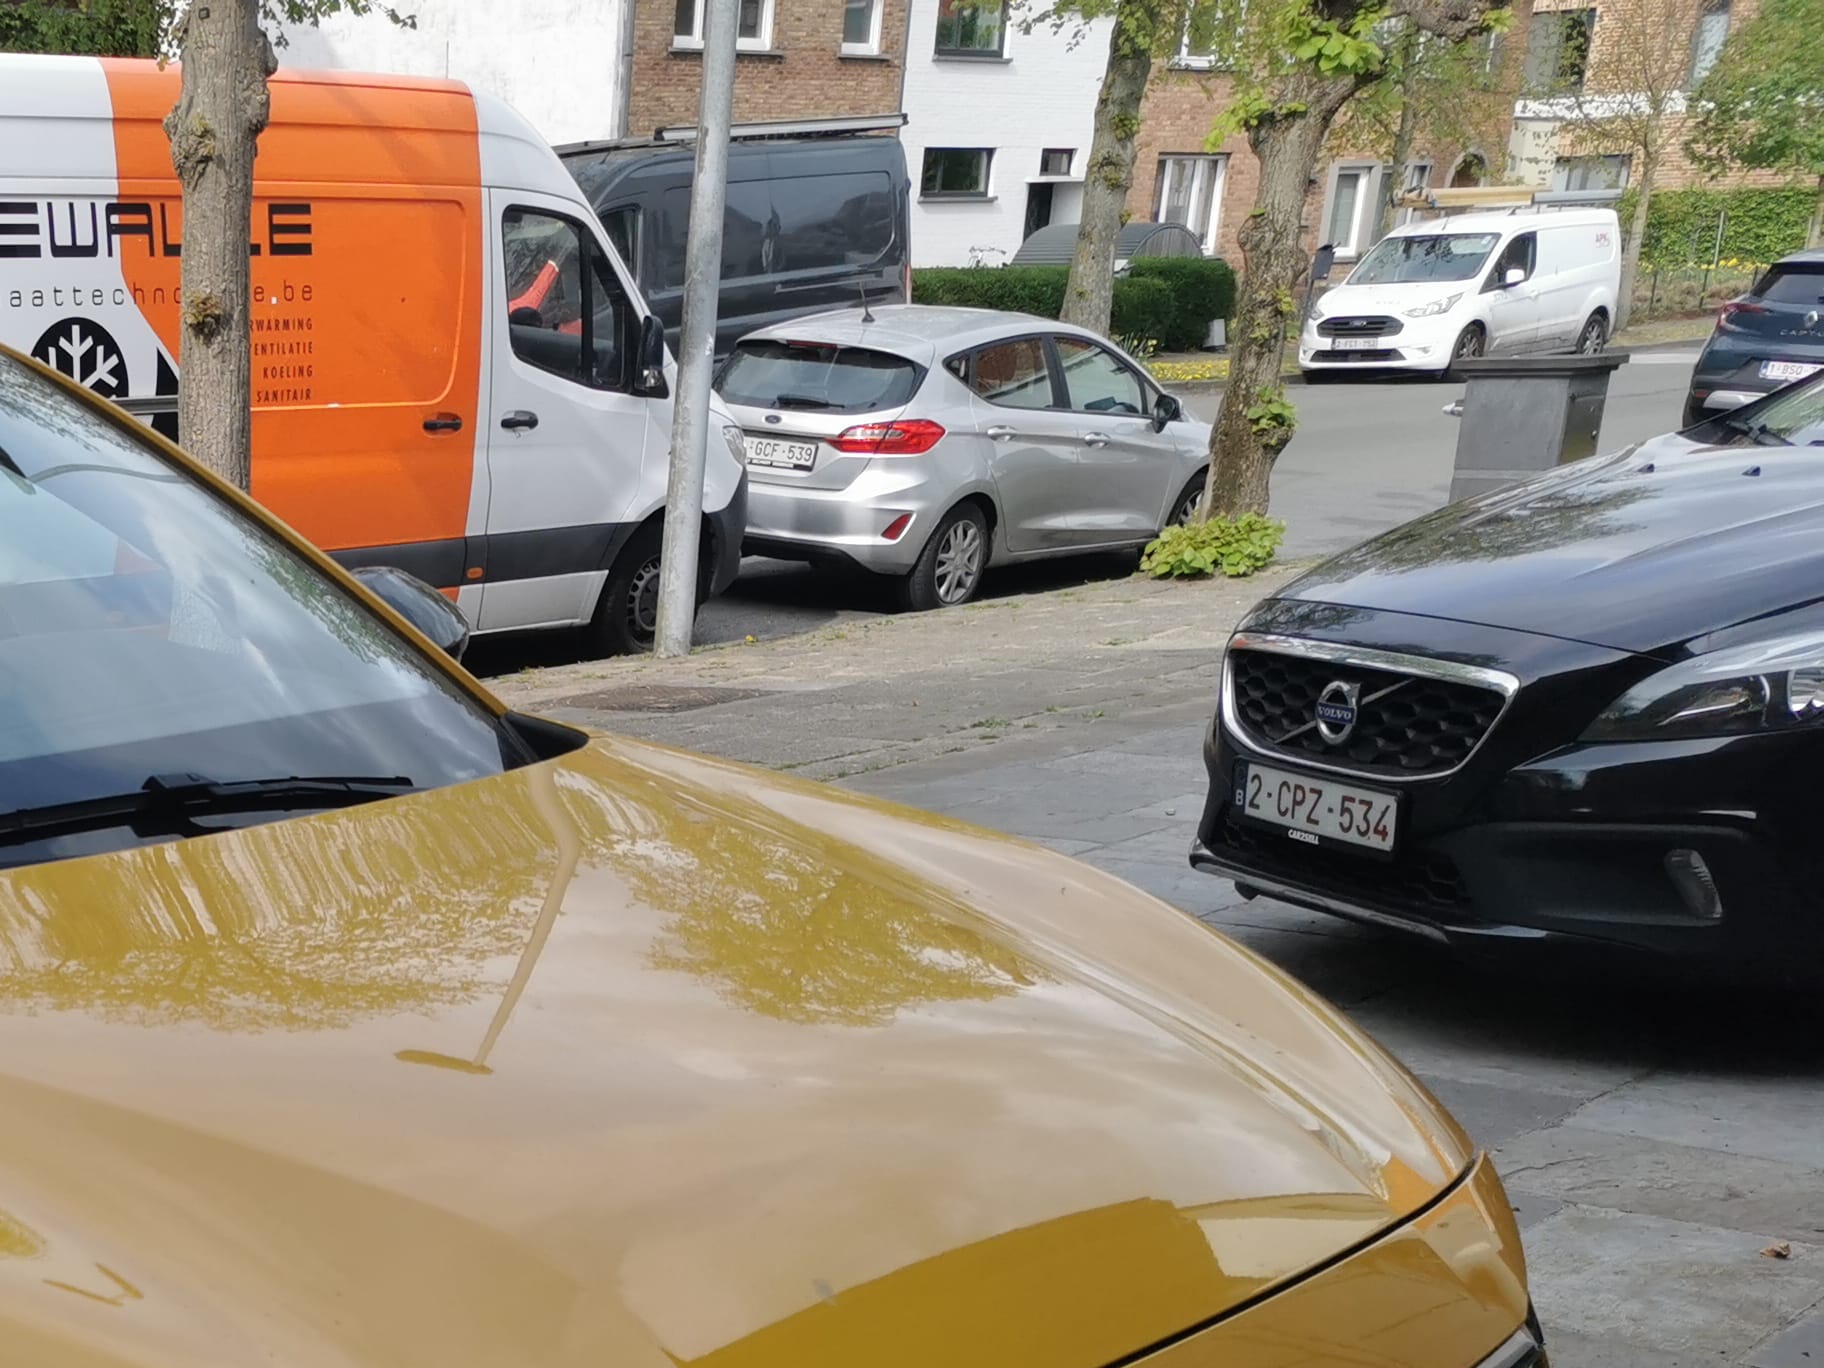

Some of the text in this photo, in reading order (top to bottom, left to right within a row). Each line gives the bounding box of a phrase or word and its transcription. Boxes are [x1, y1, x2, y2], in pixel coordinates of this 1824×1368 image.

[249, 318, 313, 333] RWARMING
[249, 341, 313, 357] ENTILATIE
[262, 364, 313, 379] KOELING
[256, 388, 312, 403] SANITAIR
[1318, 707, 1352, 720] VOLVO
[1235, 789, 1243, 805] B
